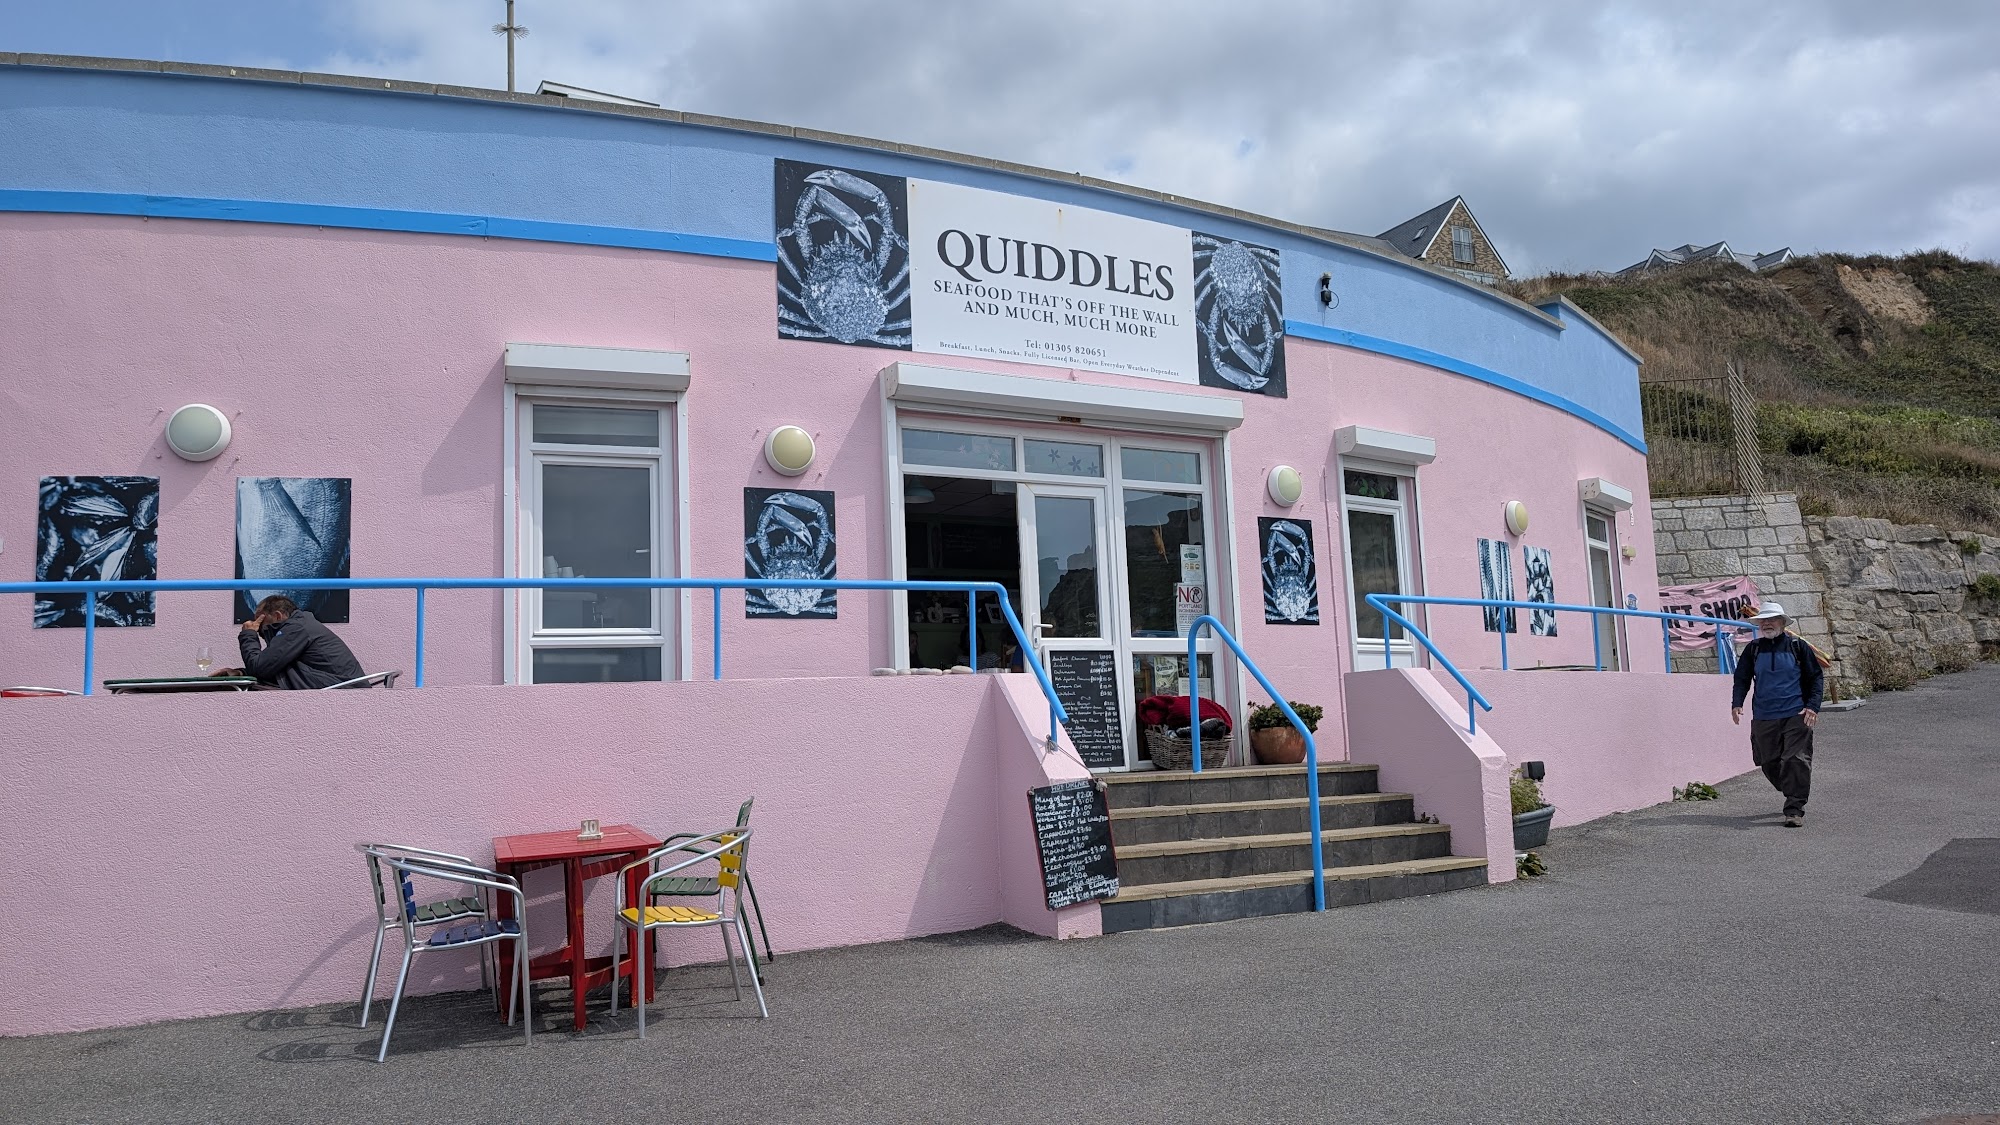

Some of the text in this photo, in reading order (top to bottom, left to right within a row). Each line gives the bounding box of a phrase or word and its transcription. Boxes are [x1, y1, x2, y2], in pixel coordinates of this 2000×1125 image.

[937, 229, 1174, 301] QUIDDLES
[933, 279, 1180, 327] SEAFOOD THAT'S OFF THE WALL
[963, 300, 1158, 339] AND MUCH, MUCH MORE
[939, 341, 973, 352] Breakfast,
[974, 345, 997, 354] Lunch,
[998, 348, 1022, 357] Snacks,
[1024, 351, 1040, 360] Fully
[1082, 358, 1099, 367] Open
[1100, 360, 1126, 370] Everyday
[1127, 363, 1149, 373] Weather
[1150, 366, 1180, 377] Dependent
[1024, 338, 1107, 358] Tel: 01305 820651
[1699, 594, 1752, 626] SHOP
[1051, 784, 1063, 792] HOT
[583, 820, 598, 834] 10
